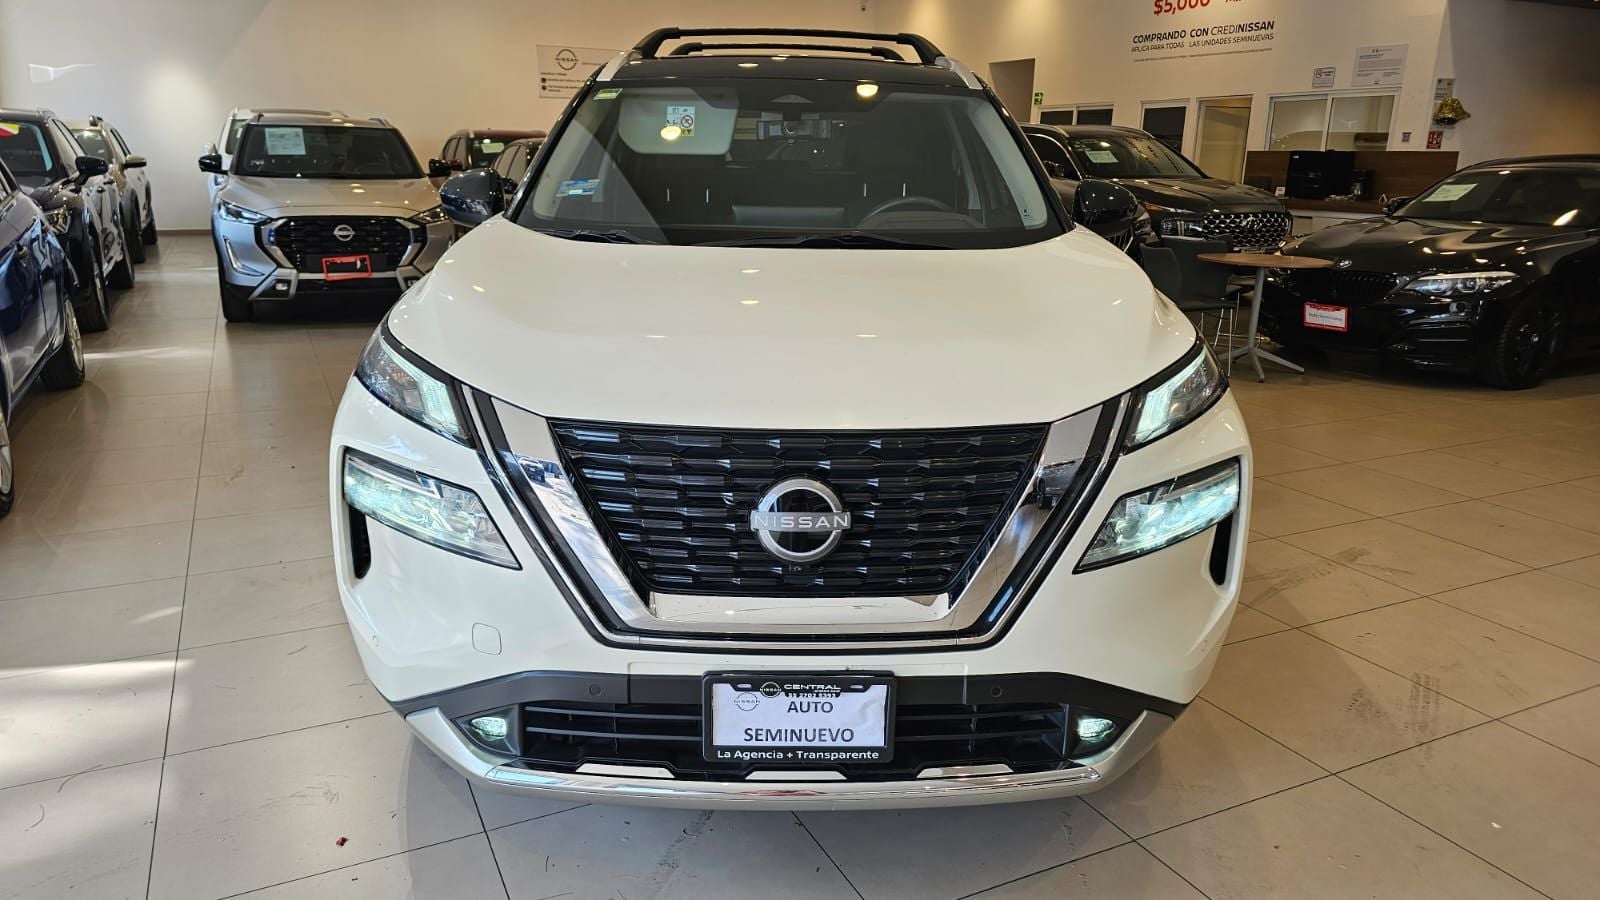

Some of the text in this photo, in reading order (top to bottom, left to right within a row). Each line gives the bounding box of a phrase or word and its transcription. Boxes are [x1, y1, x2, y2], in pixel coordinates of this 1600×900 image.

[1132, 20, 1275, 44] COMPRANDO CON CREDINISSAN
[1130, 32, 1275, 53] APLICA PARA TODAS LAS UNIDADES SEMINUEVAS
[753, 515, 849, 529] NISSAN
[786, 701, 834, 713] AUTO
[743, 728, 855, 743] SEMINUEVO
[717, 750, 731, 758] La
[734, 750, 784, 760] Agencia
[796, 750, 880, 761] Transparente
